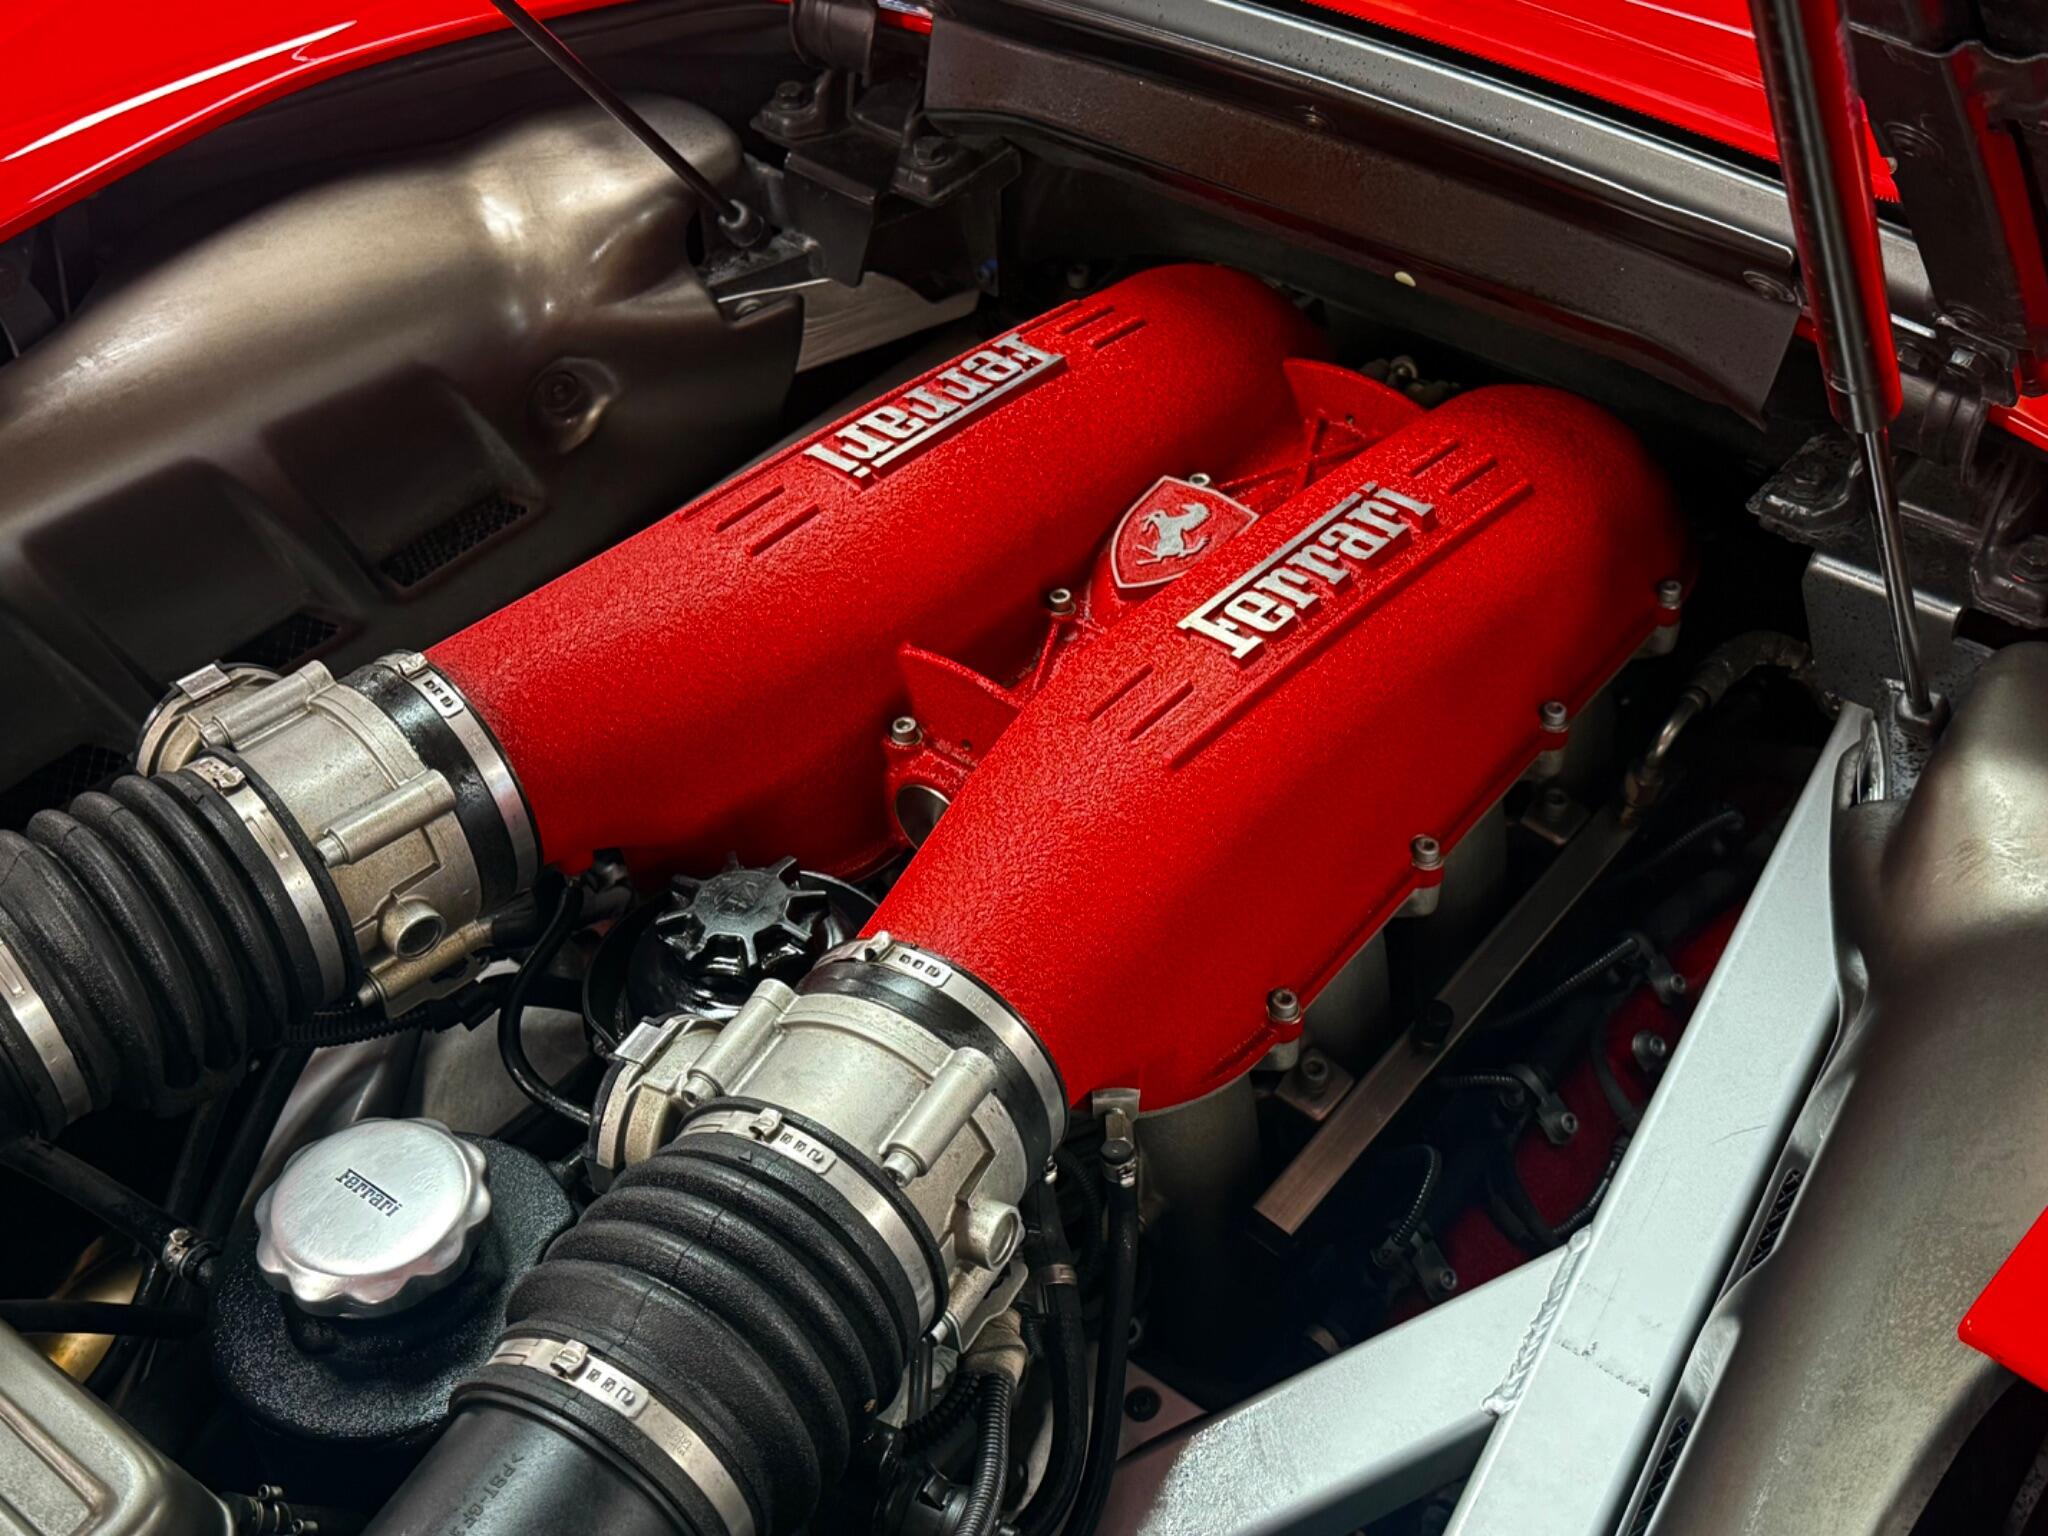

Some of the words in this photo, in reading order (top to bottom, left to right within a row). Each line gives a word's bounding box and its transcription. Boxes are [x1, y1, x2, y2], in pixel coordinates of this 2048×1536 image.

[803, 332, 1066, 478] Ferrari
[1176, 481, 1434, 659] Ferrari
[335, 1168, 403, 1217] Ferrari
